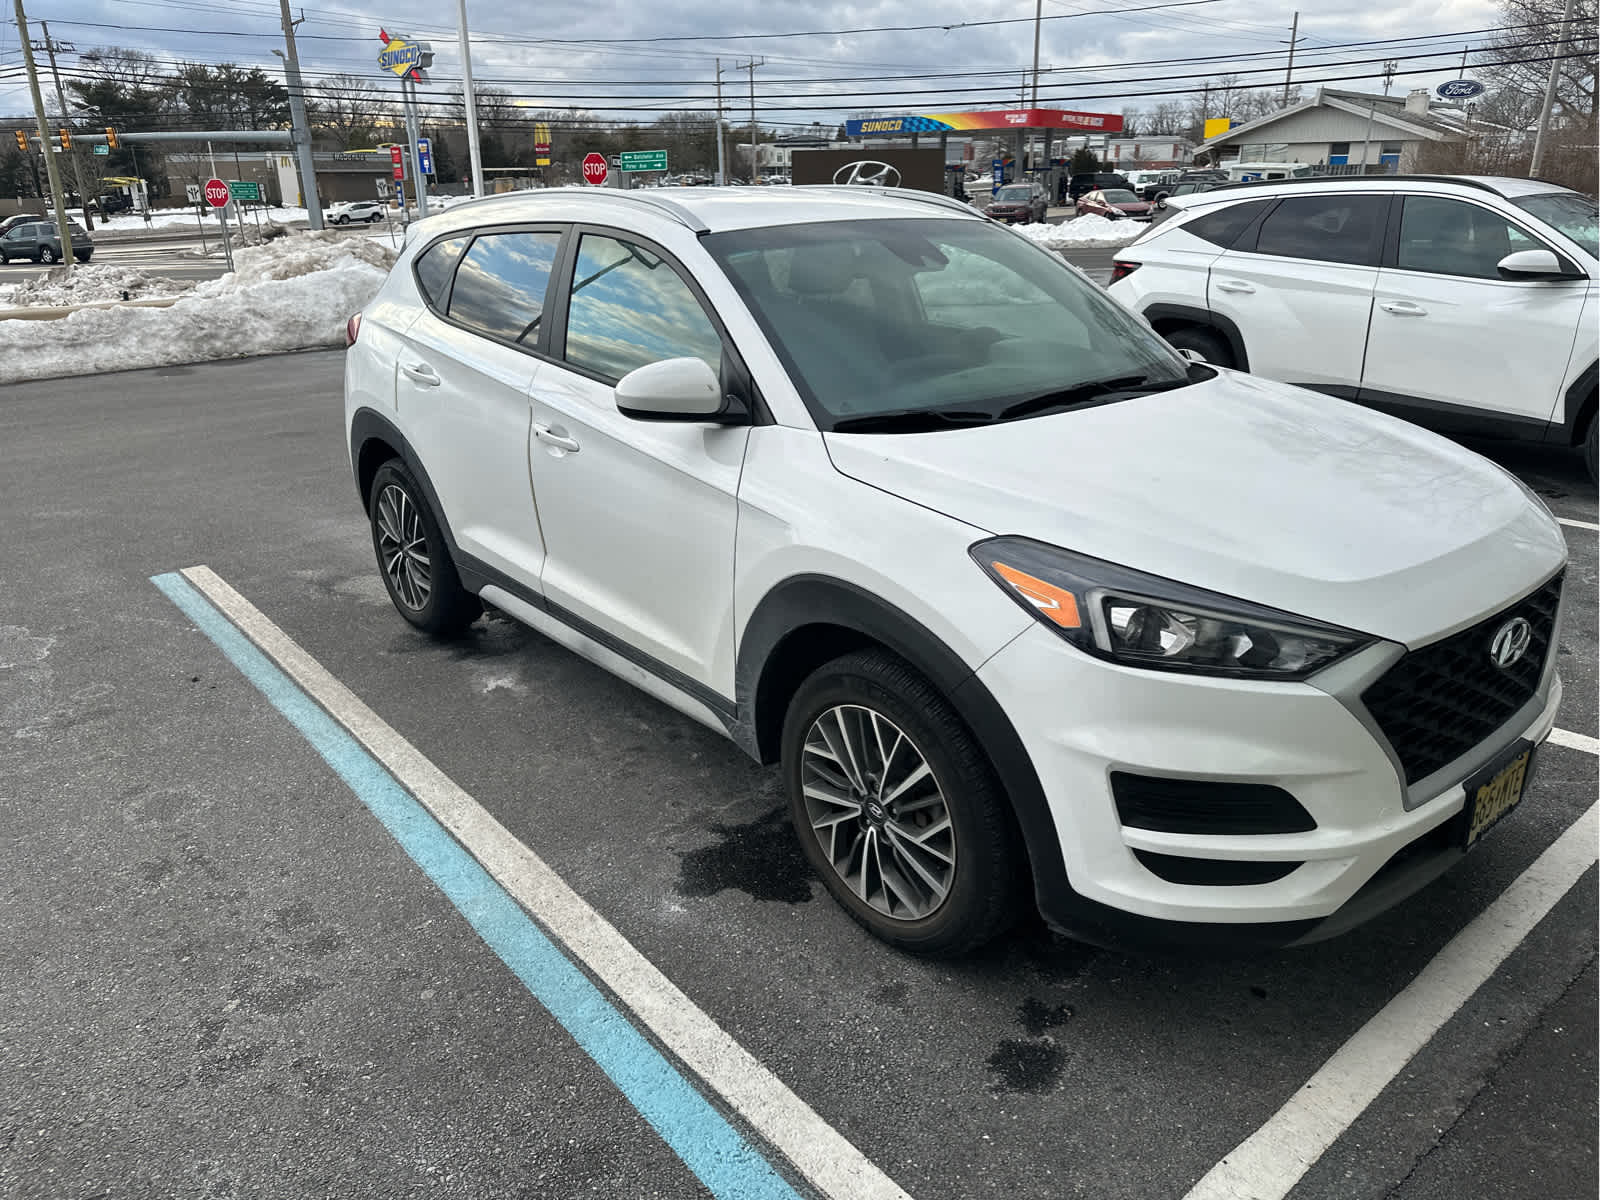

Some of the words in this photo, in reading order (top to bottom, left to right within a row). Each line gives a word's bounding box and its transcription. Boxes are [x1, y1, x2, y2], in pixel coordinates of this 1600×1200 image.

[381, 46, 417, 67] SUNOCO
[1445, 83, 1474, 95] Ford
[861, 120, 903, 133] SUNOCO
[584, 163, 606, 176] STOP
[206, 187, 227, 199] STOP
